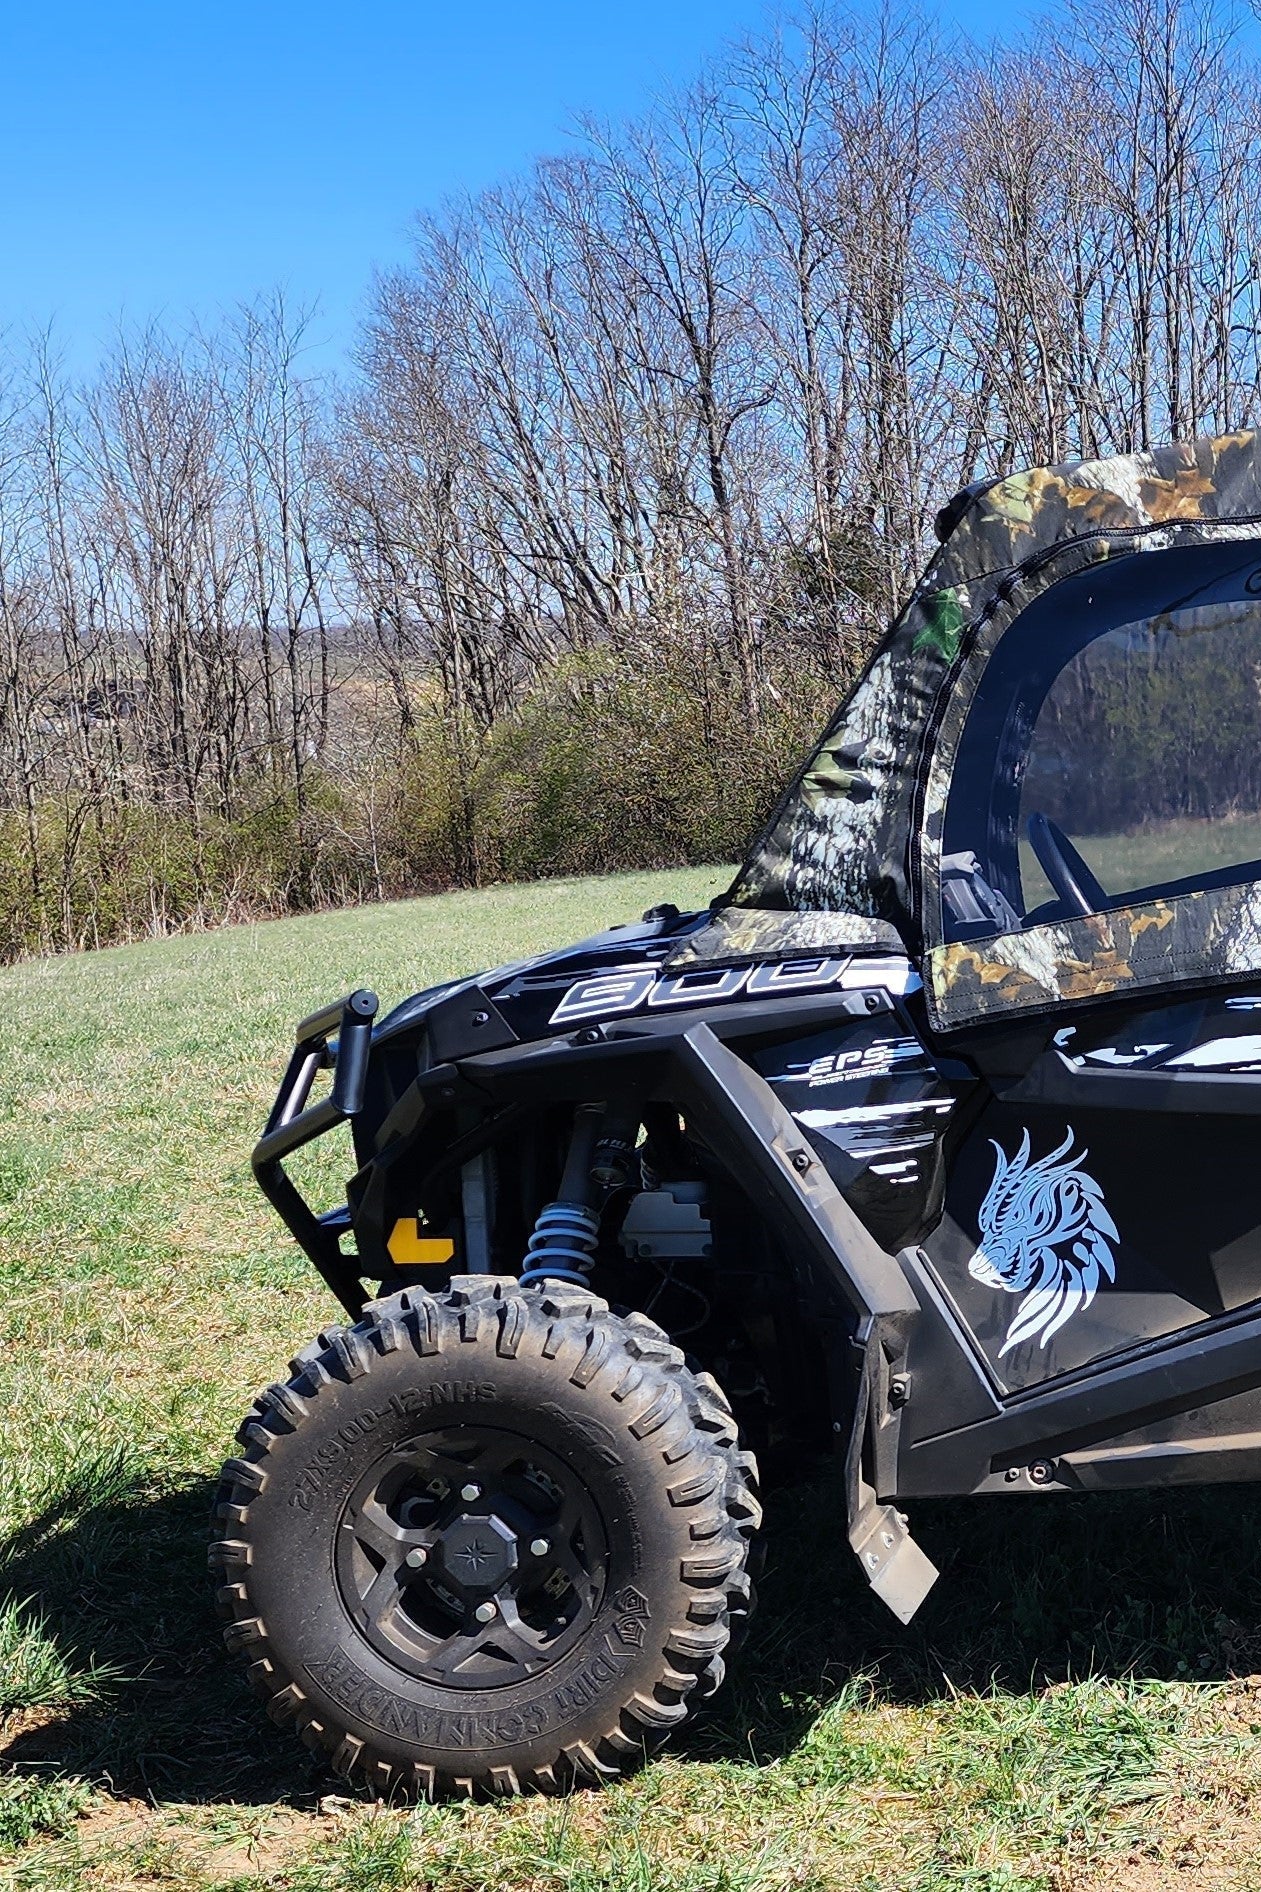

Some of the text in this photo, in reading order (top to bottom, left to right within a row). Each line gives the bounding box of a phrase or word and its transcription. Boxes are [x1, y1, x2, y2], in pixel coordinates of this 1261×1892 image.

[548, 955, 852, 1025] 900
[808, 1045, 889, 1075] EPS
[429, 1380, 498, 1404] NHS
[319, 1649, 625, 1747] DIRT COMMANDER
